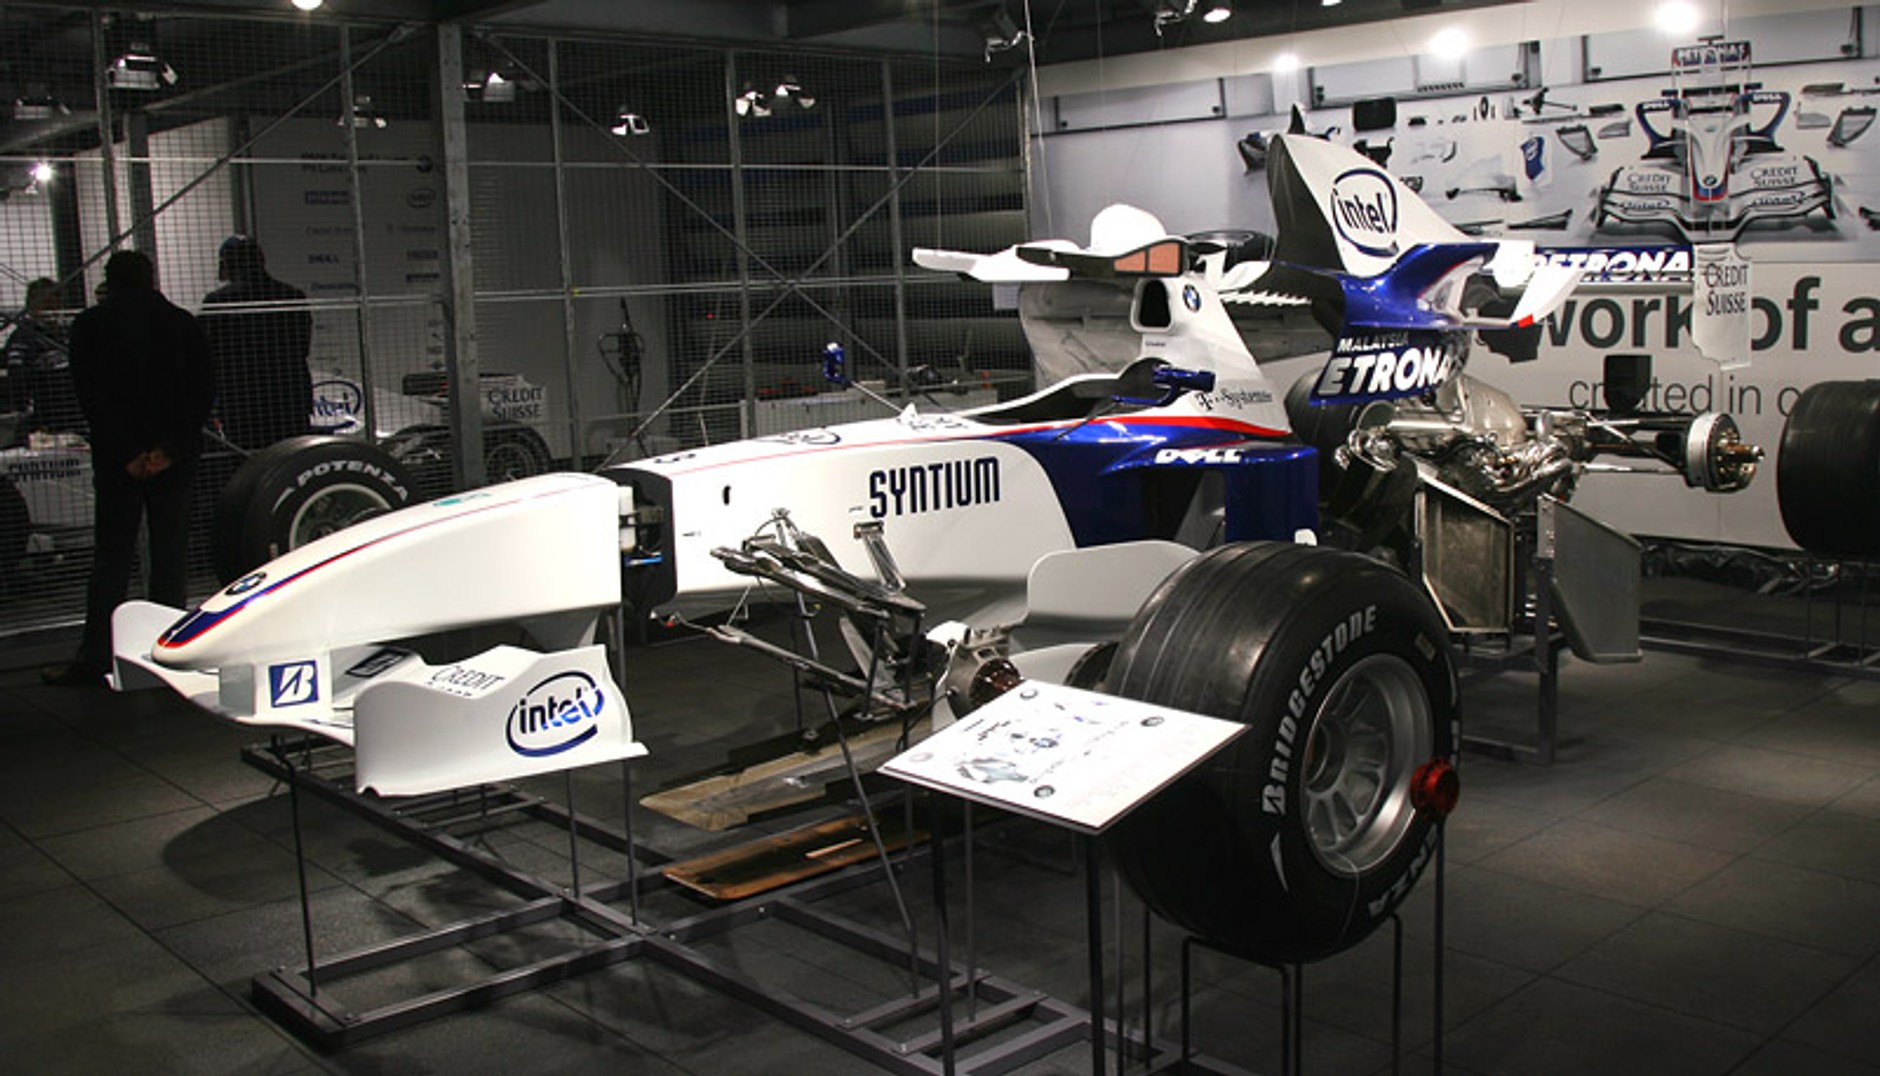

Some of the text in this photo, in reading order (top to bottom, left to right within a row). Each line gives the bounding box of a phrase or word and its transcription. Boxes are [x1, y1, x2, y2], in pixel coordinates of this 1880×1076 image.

[1332, 187, 1391, 234] intel
[1705, 262, 1748, 289] CREDIT
[1706, 291, 1747, 316] SUISSE
[298, 459, 409, 502] POTENZA
[869, 456, 1001, 519] SYNTIUM
[430, 665, 505, 690] CREDIT
[519, 685, 593, 735] intel
[1261, 604, 1378, 816] BRIDGESTONE
